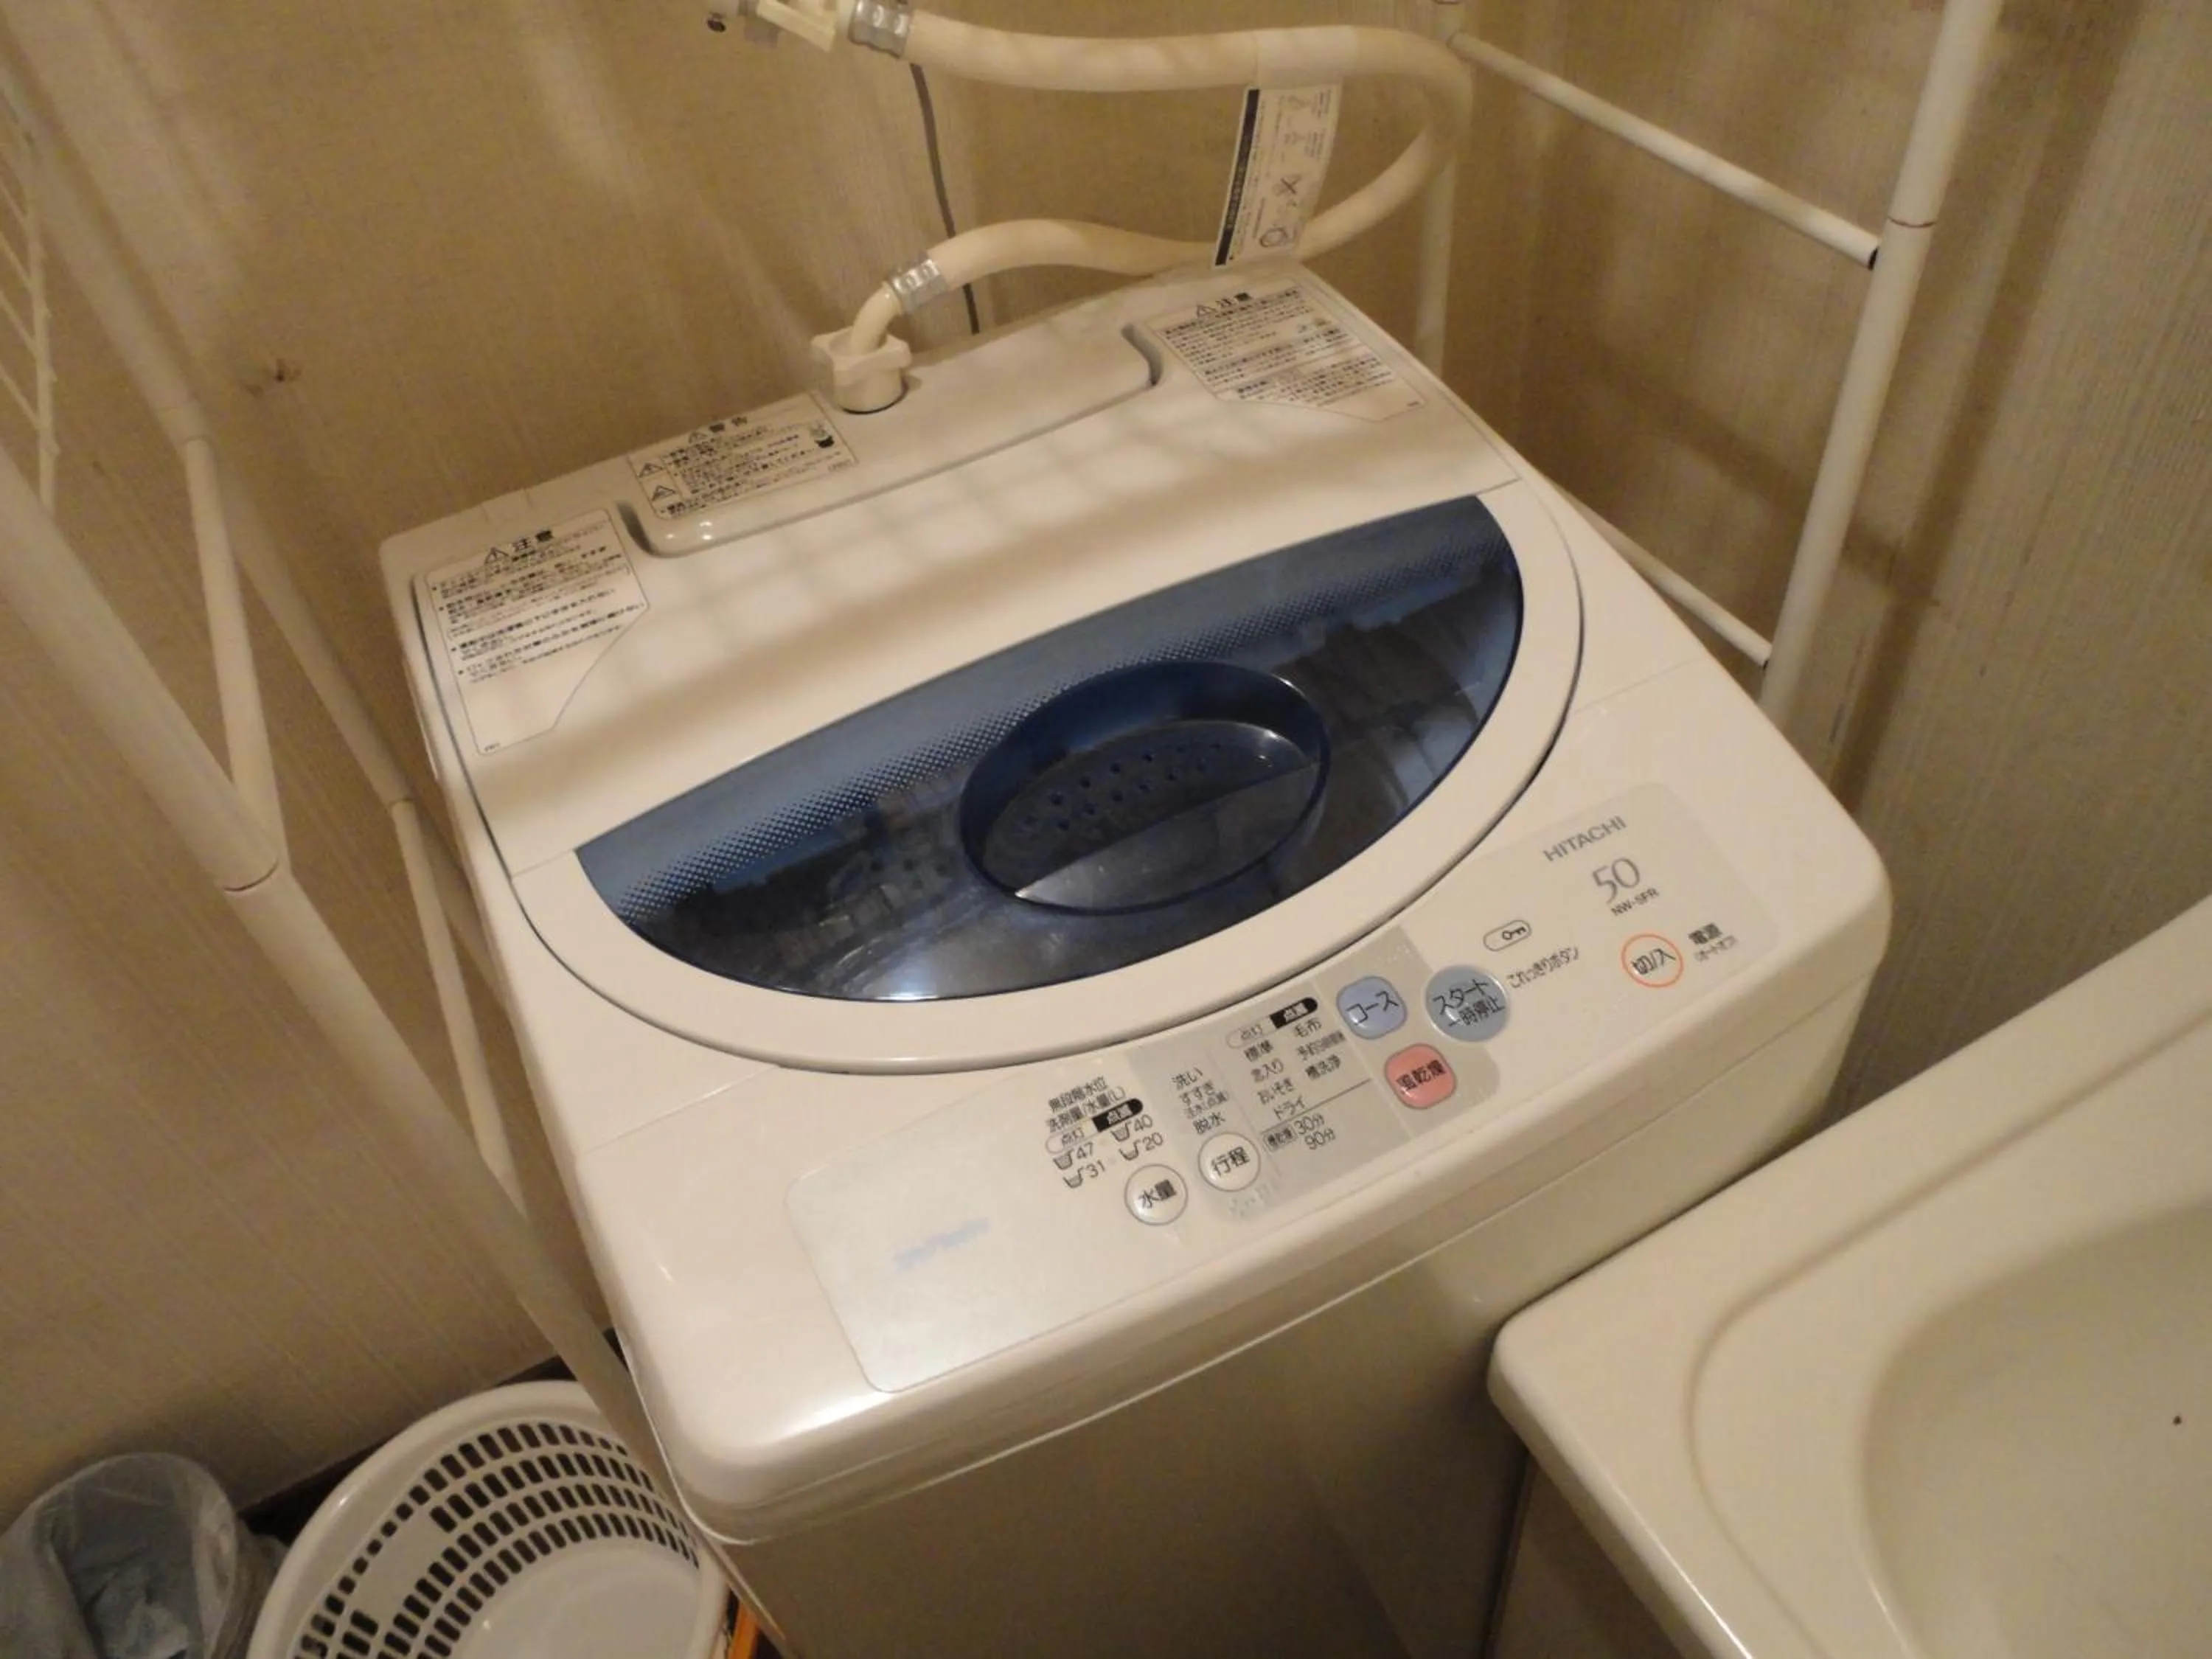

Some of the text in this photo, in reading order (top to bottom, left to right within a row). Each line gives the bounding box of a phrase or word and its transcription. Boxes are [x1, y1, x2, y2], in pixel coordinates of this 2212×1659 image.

[1543, 815, 1627, 862] HITACHI
[1592, 858, 1641, 905] 50
[1346, 990, 1399, 1026] コース
[1433, 978, 1489, 1015] スタート
[1448, 995, 1506, 1027] 一時停止
[1171, 1066, 1203, 1090] 洗い
[1273, 1094, 1305, 1121] ドライ
[1133, 1114, 1153, 1132] 40
[1192, 1111, 1226, 1134] 脱水
[1077, 1141, 1094, 1160] 47
[1142, 1132, 1164, 1151] 20
[1086, 1159, 1106, 1178] 31
[1211, 1146, 1251, 1178] 行程
[1138, 1179, 1177, 1209] 水量
